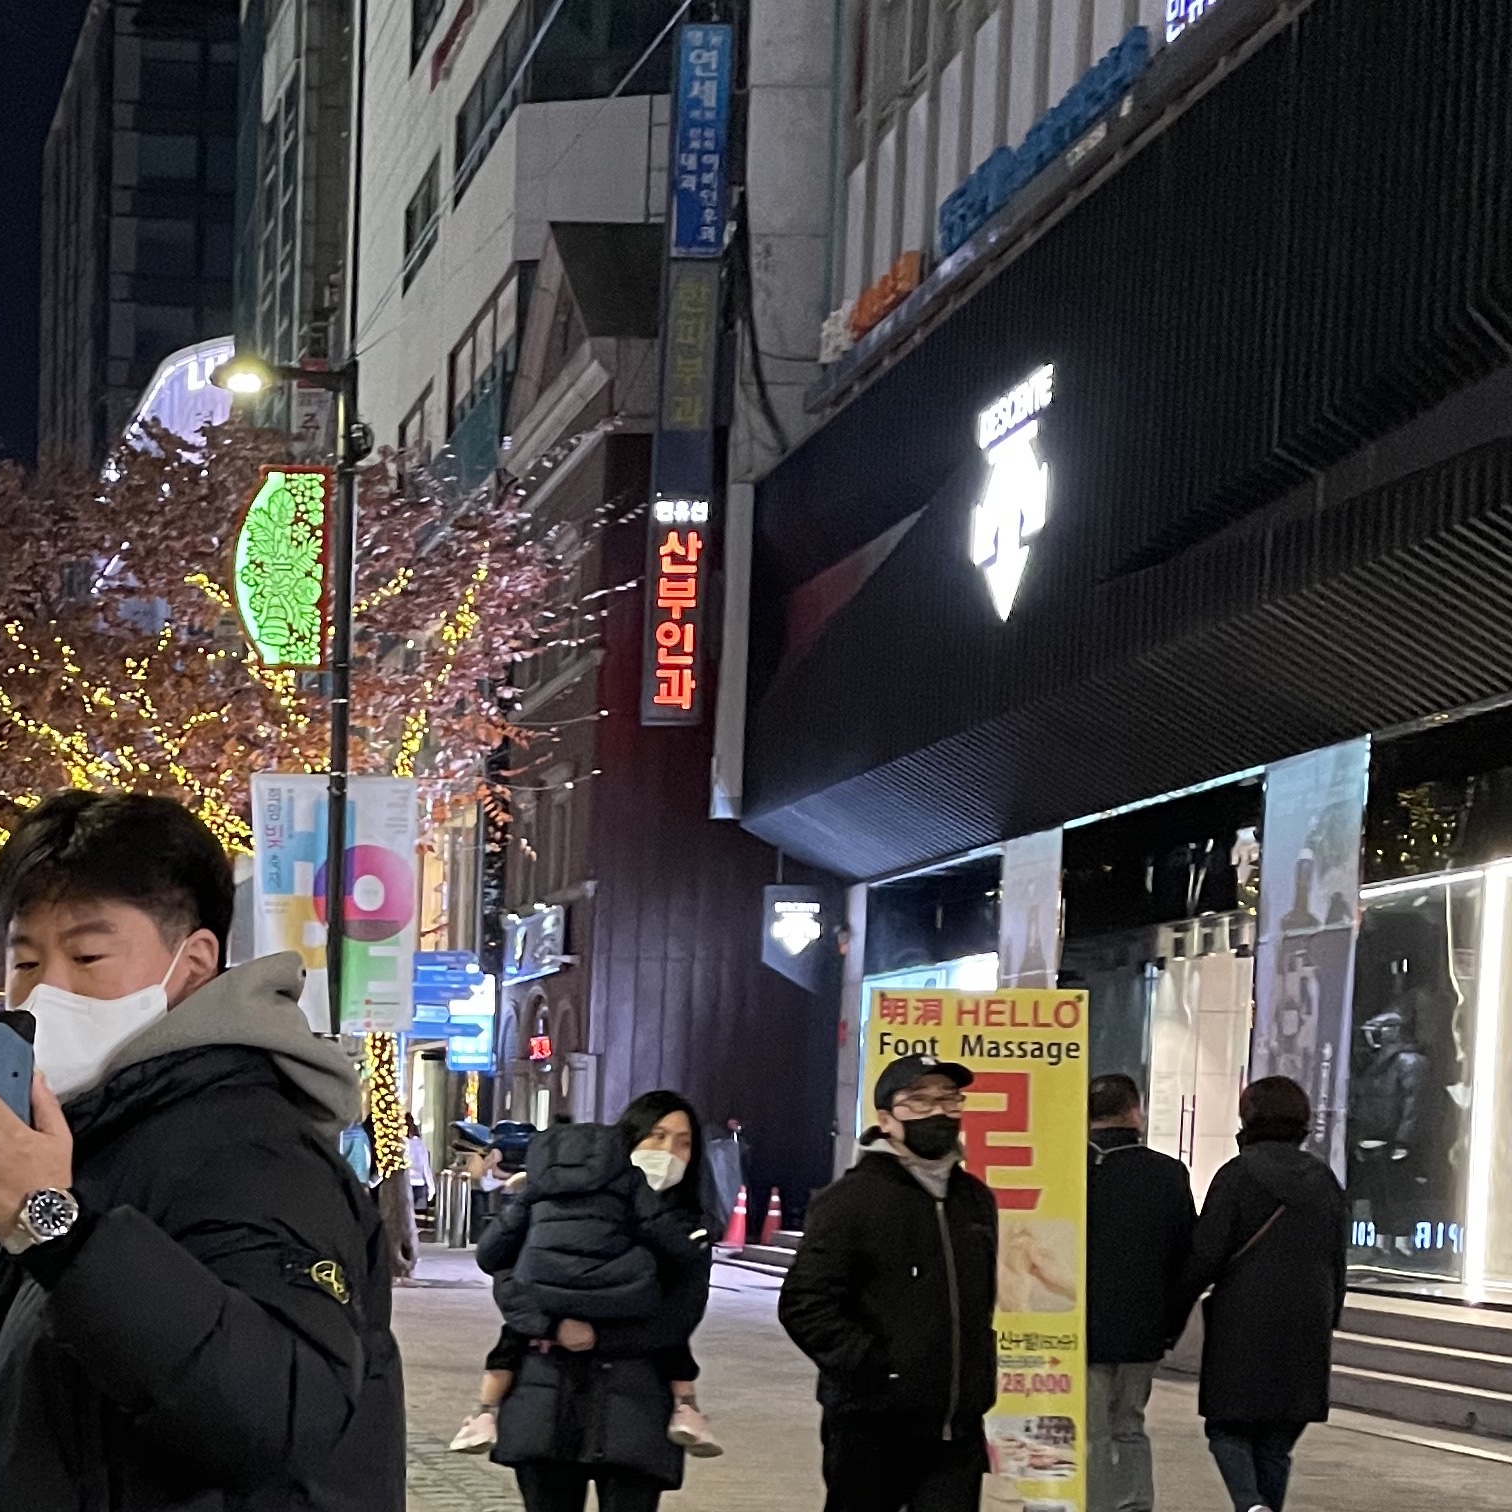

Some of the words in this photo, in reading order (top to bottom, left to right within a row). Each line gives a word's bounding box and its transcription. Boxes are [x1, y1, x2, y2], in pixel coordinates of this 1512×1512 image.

[653, 531, 703, 710] 산부인과
[955, 998, 1080, 1028] HELLO
[879, 1032, 940, 1056] Foot
[960, 1034, 1081, 1066] Massage
[1001, 1372, 1072, 1398] 28,000
